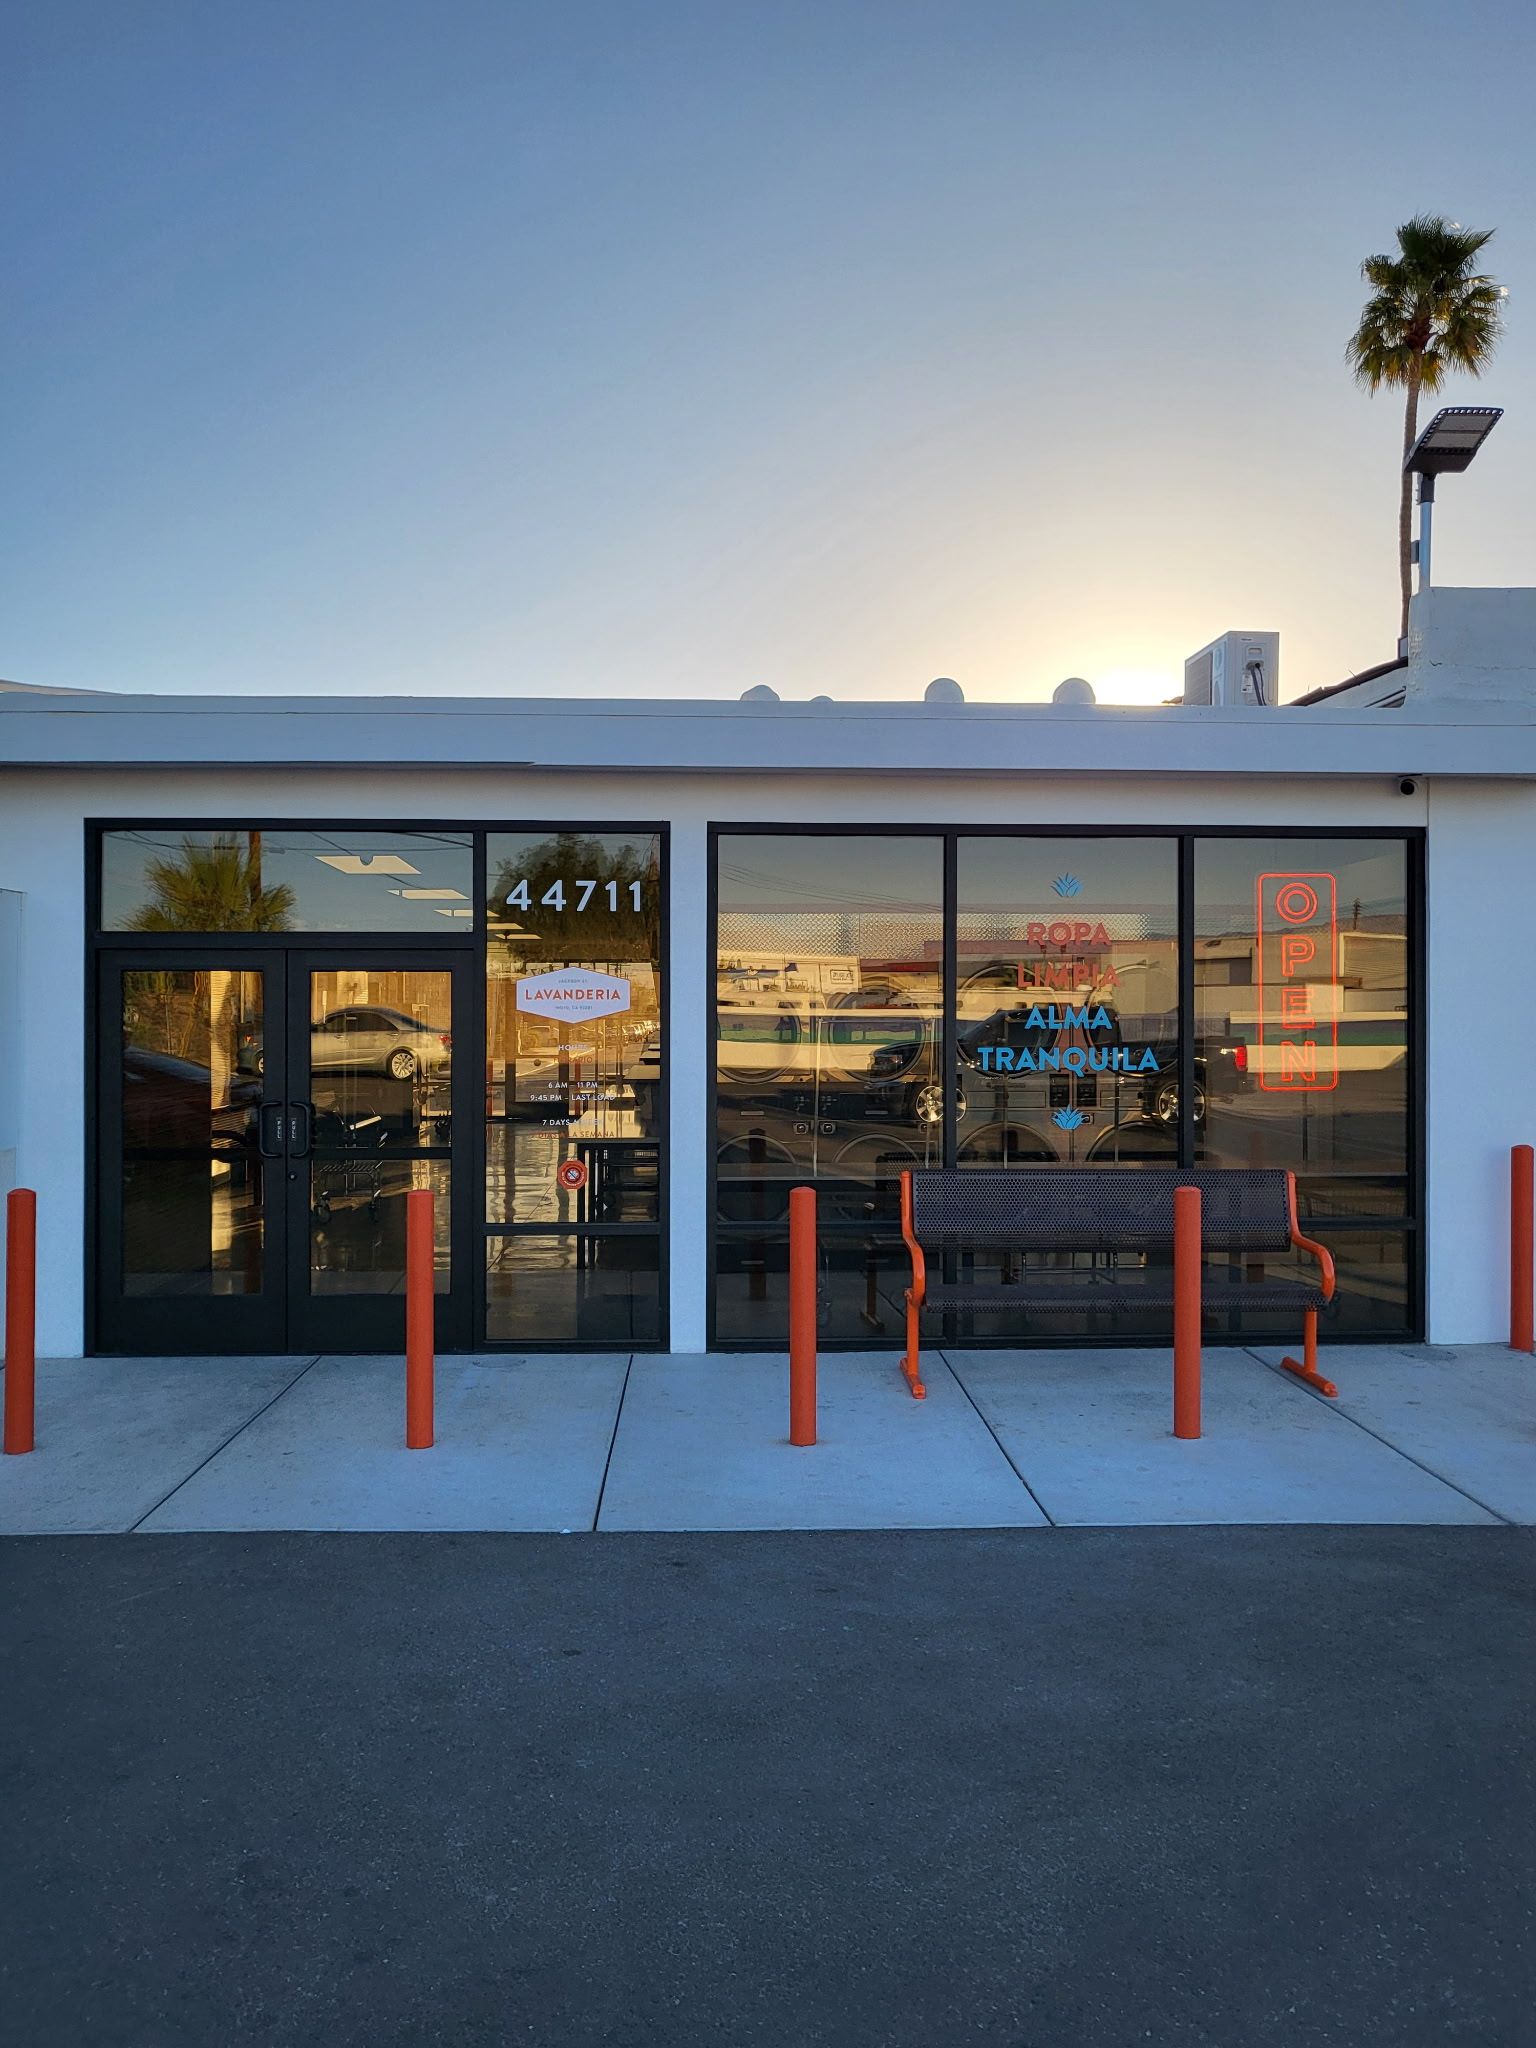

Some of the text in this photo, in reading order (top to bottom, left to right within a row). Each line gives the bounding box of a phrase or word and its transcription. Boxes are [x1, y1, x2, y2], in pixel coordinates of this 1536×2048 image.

[506, 879, 641, 912] 44711
[1027, 922, 1112, 946] ROPA
[1017, 961, 1120, 988] LIMPIA
[1276, 882, 1318, 1082] OPEN
[525, 989, 620, 1000] LAVANDERIA
[1024, 1005, 1112, 1030] ALMA
[977, 1046, 1160, 1077] TRANQUILA
